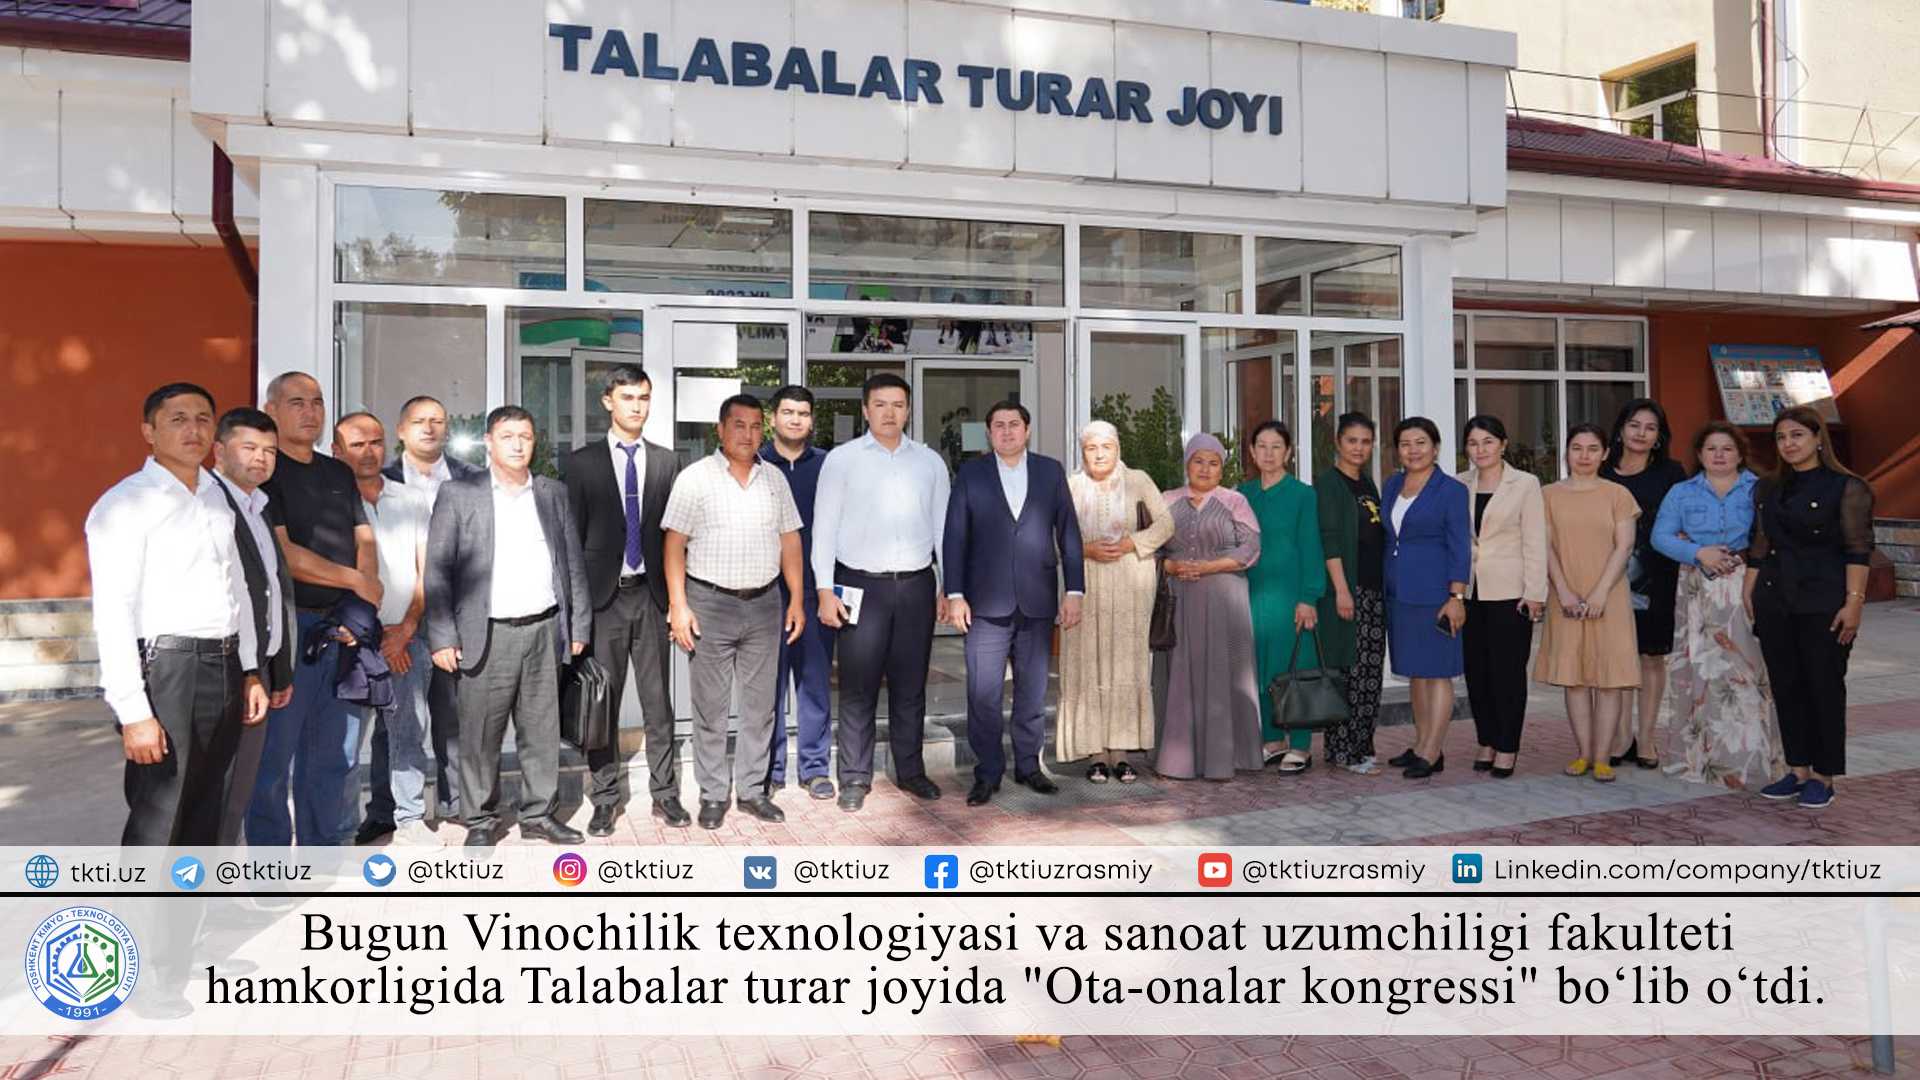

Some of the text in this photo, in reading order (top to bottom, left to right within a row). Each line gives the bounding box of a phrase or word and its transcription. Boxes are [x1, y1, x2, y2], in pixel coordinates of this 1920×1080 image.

[549, 24, 1283, 136] TALABALAR TURAR JOYI
